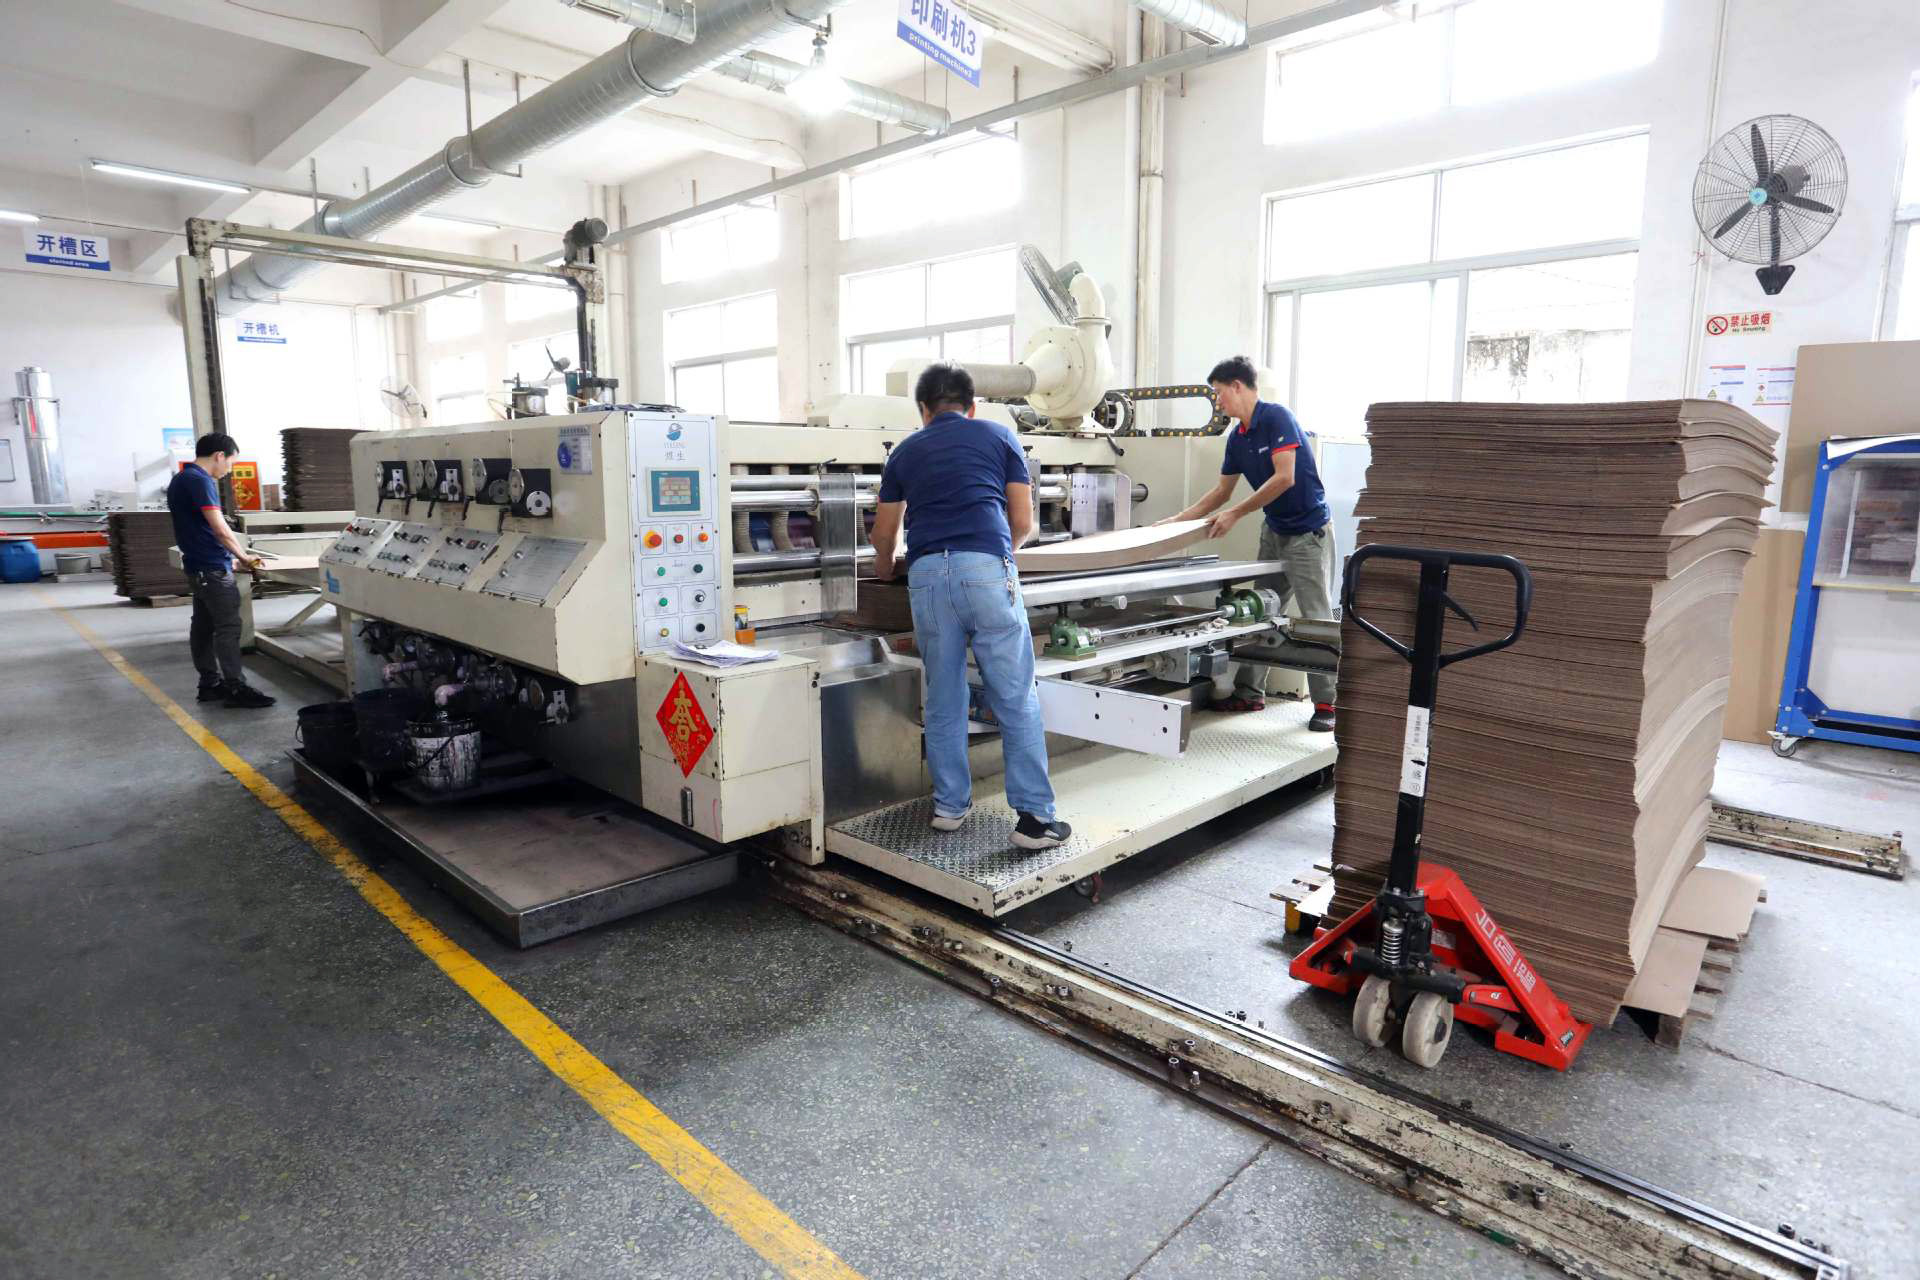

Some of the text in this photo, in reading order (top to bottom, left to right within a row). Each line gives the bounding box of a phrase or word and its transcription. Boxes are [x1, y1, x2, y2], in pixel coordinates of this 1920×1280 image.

[909, 32, 940, 58] printing
[37, 234, 98, 257] 开槽区
[1731, 313, 1770, 327] 禁止吸烟
